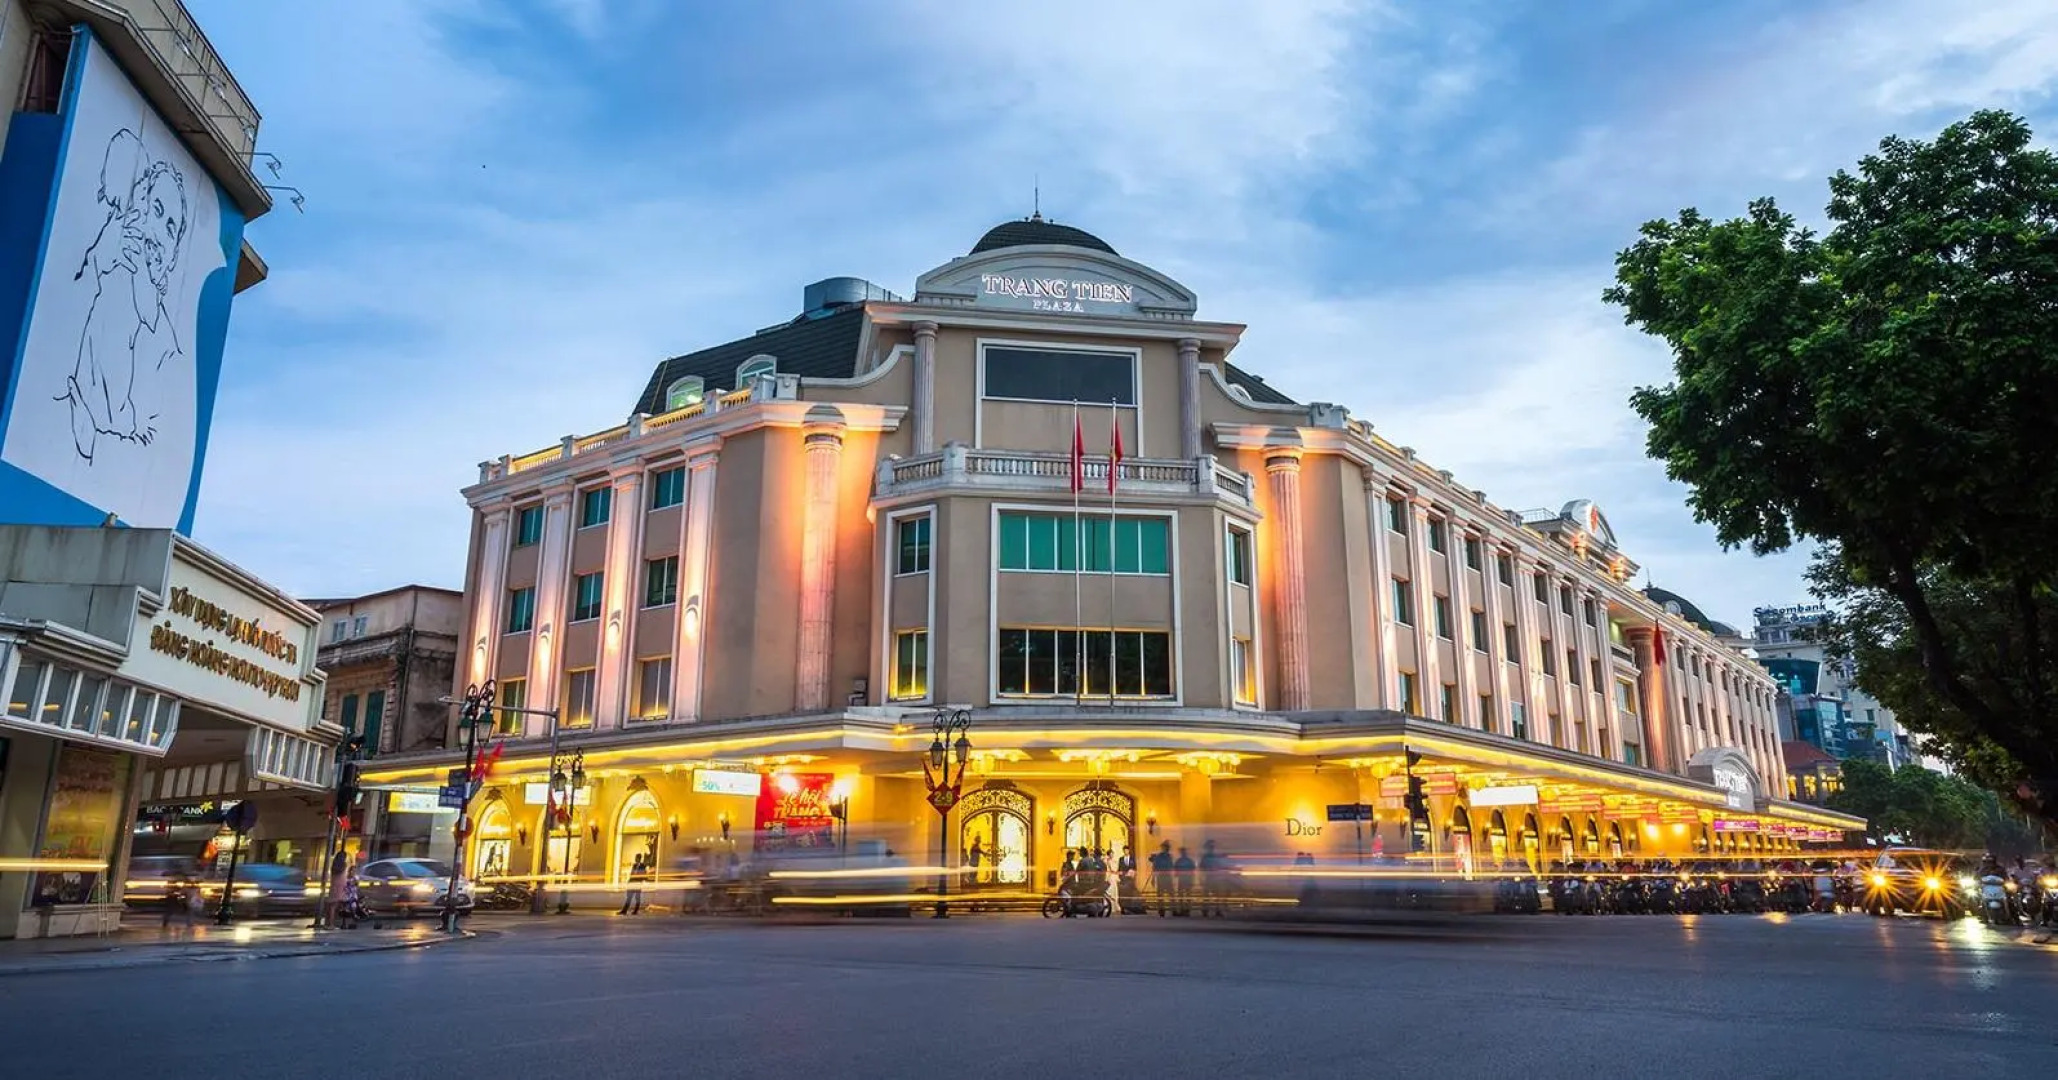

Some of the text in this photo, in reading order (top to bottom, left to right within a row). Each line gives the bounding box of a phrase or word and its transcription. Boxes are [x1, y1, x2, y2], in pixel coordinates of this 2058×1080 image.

[981, 273, 1133, 303] TRANG TIEN
[1032, 299, 1084, 313] PLAZA
[1285, 818, 1322, 836] Dior
